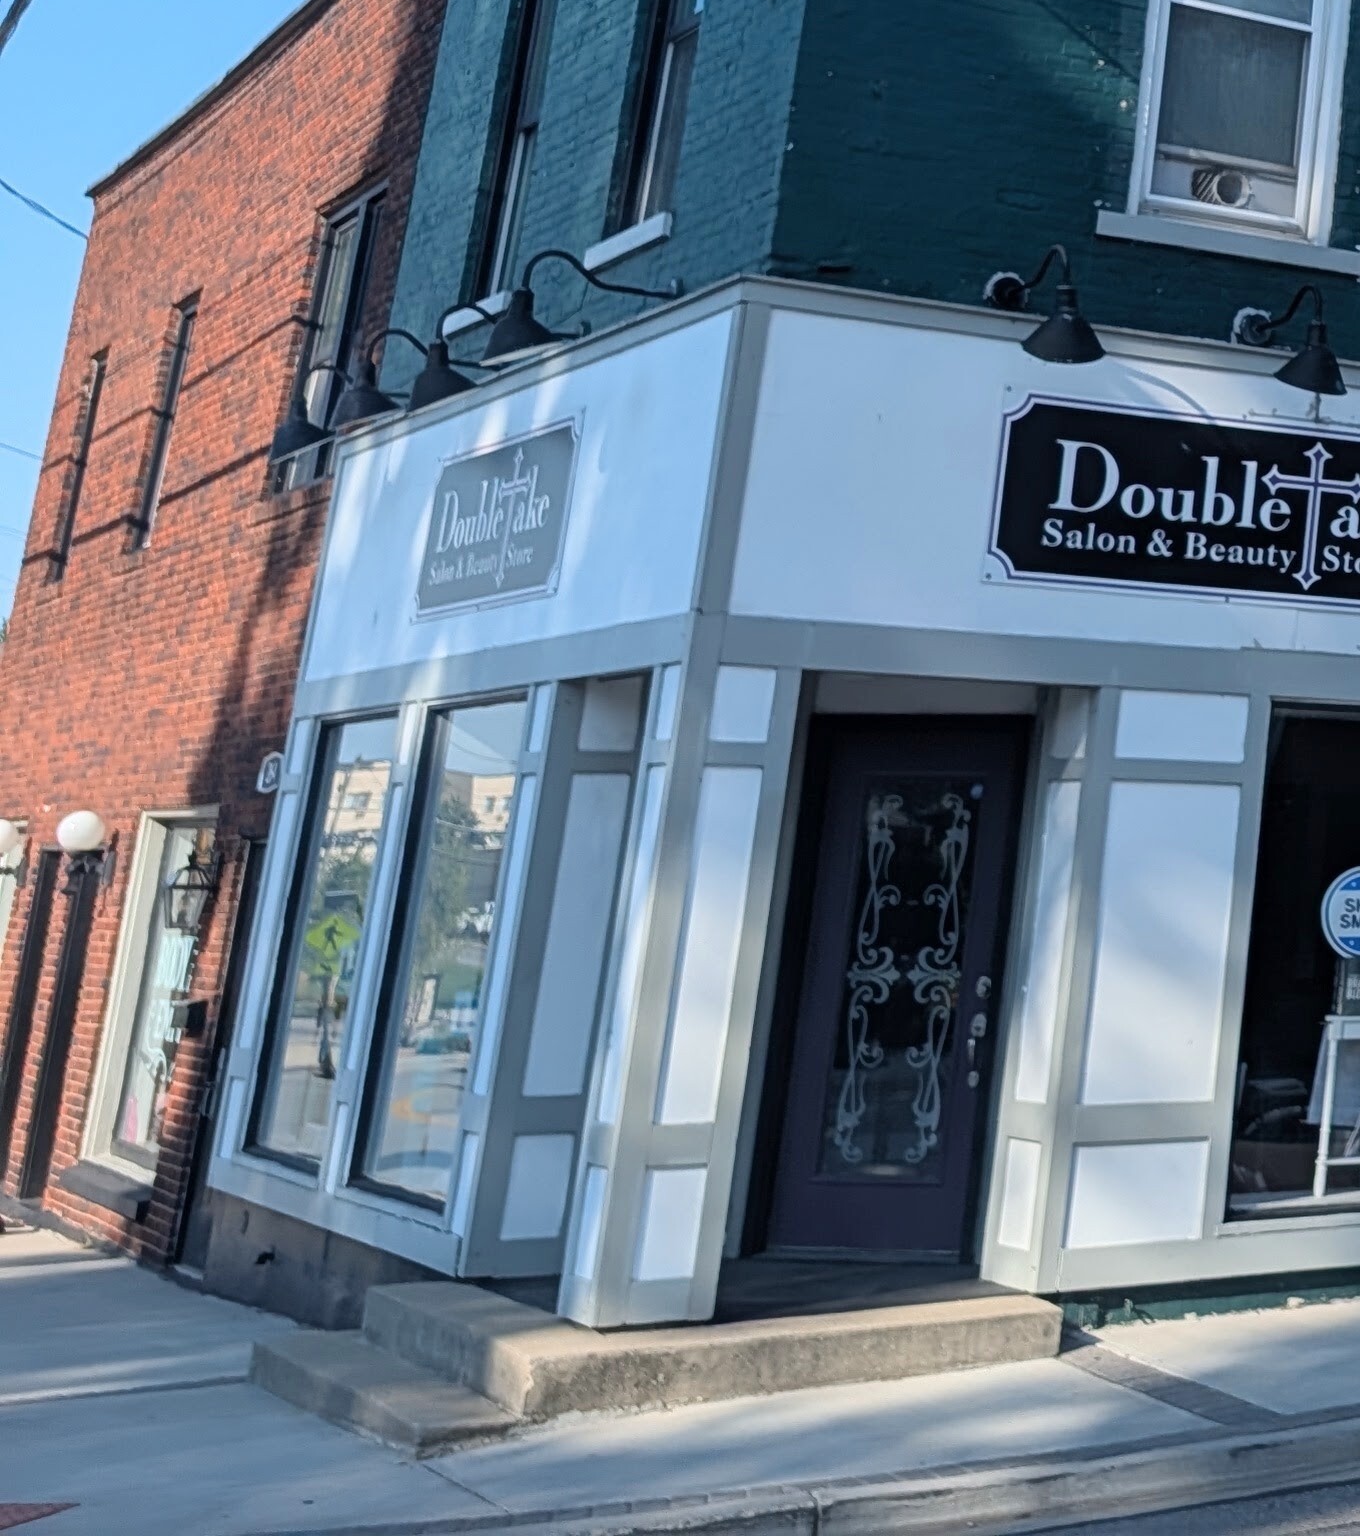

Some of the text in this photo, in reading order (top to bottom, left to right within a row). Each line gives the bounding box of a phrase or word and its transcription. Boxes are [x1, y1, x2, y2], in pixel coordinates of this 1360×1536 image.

[436, 477, 503, 553] Double
[1048, 438, 1293, 533] Double
[1041, 517, 1137, 555] Salon
[1146, 528, 1173, 557] &
[1184, 531, 1298, 574] Beauty
